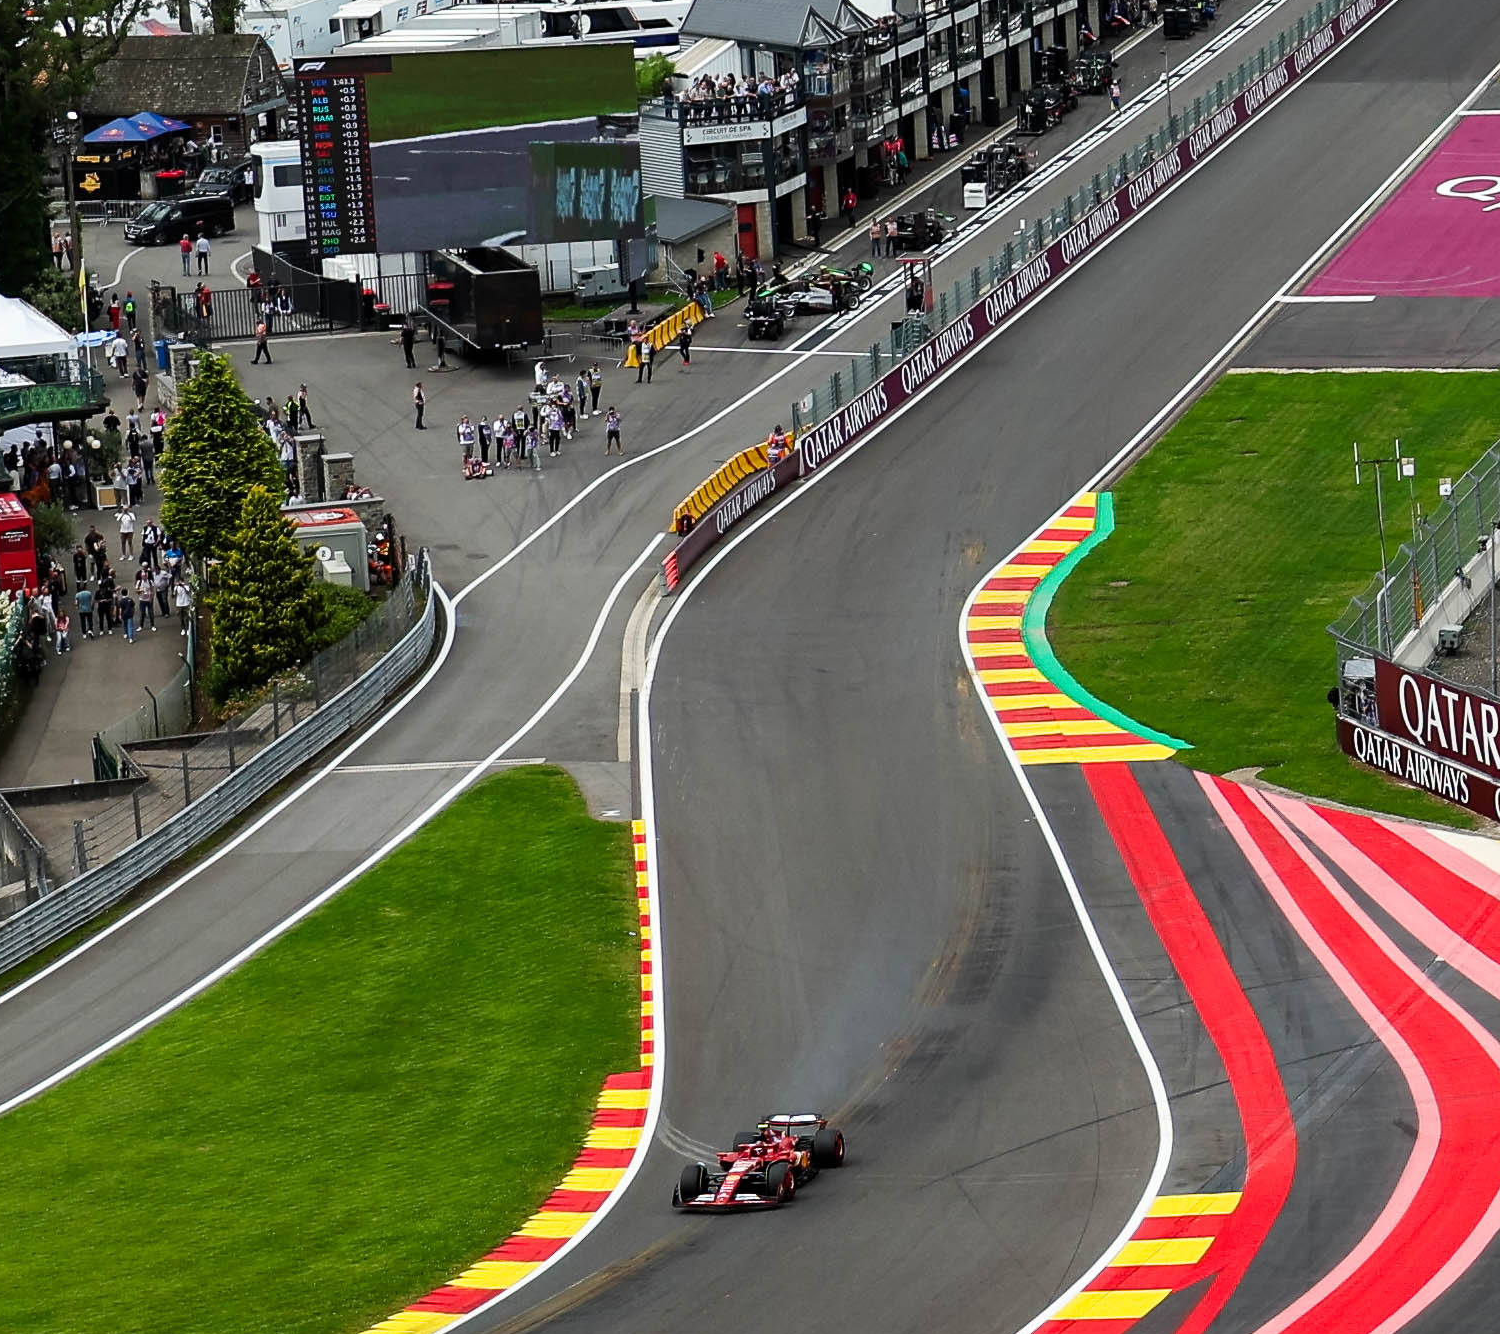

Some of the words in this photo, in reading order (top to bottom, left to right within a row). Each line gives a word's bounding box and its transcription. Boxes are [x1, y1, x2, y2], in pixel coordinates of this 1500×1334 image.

[313, 114, 334, 122] HAM
[340, 95, 356, 103] +0.7
[340, 104, 357, 112] +0.8
[1189, 125, 1212, 160] QATAR
[1212, 103, 1237, 139] AIRWAYS
[1129, 173, 1153, 210] QATAR
[1153, 148, 1181, 188] AIRWAYS
[320, 211, 337, 219] TSU
[349, 218, 365, 226] +2.2
[349, 227, 366, 235] +2.4
[1062, 224, 1089, 265] QATAR
[1089, 196, 1120, 240] AIRWAYS
[985, 283, 1016, 327] QATAR
[1016, 252, 1051, 299] AIRWAYS
[901, 347, 936, 394] QATAR
[936, 313, 974, 372] AIRWAYS
[804, 418, 844, 469] QATAR
[845, 381, 888, 442] AIRWAYS
[716, 496, 742, 535] QATAR
[741, 469, 777, 519] AIRWAYS
[1352, 727, 1403, 777] QATAR
[1405, 747, 1470, 806] AIRWAYS
